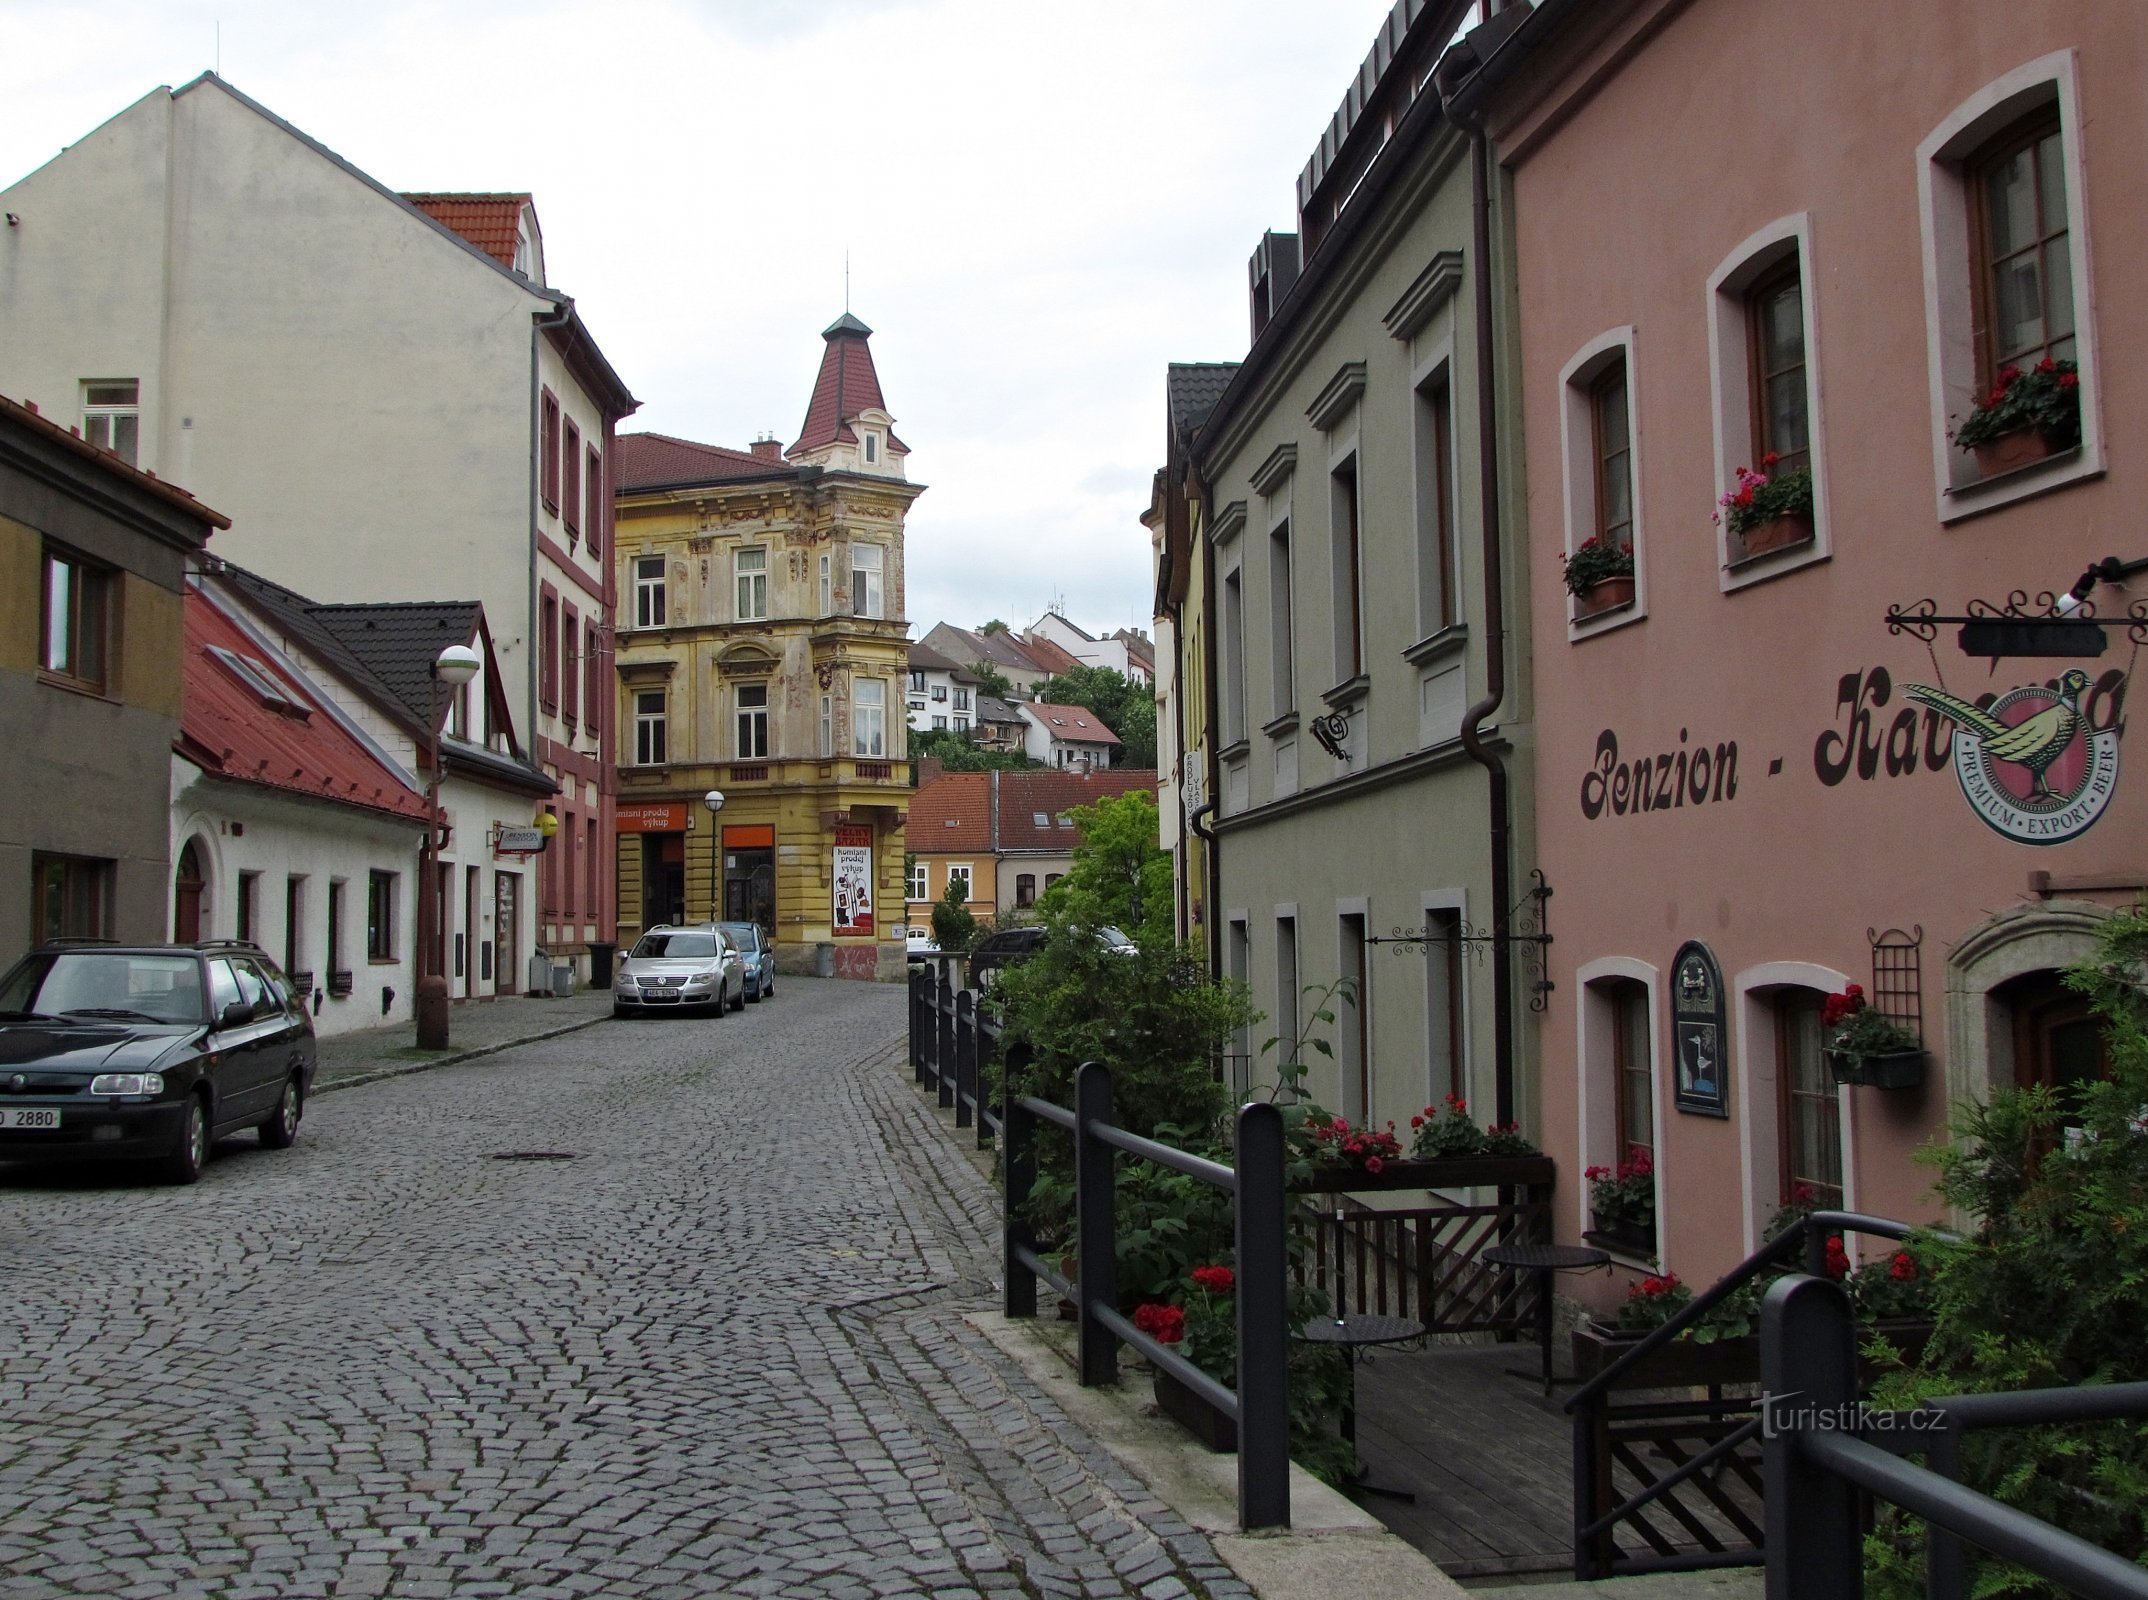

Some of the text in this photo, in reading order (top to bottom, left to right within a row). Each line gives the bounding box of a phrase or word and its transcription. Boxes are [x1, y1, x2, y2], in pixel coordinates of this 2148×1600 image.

[1581, 656, 2127, 820] Penzion - Kava
[1961, 750, 2114, 834] PREMIUM EXPORT BEER
[616, 808, 669, 818] omisní prodej
[643, 818, 669, 828] výkup
[838, 848, 867, 856] komisní
[841, 855, 863, 864] prodej
[842, 865, 864, 873] výkup
[16, 1111, 53, 1126] 2880
